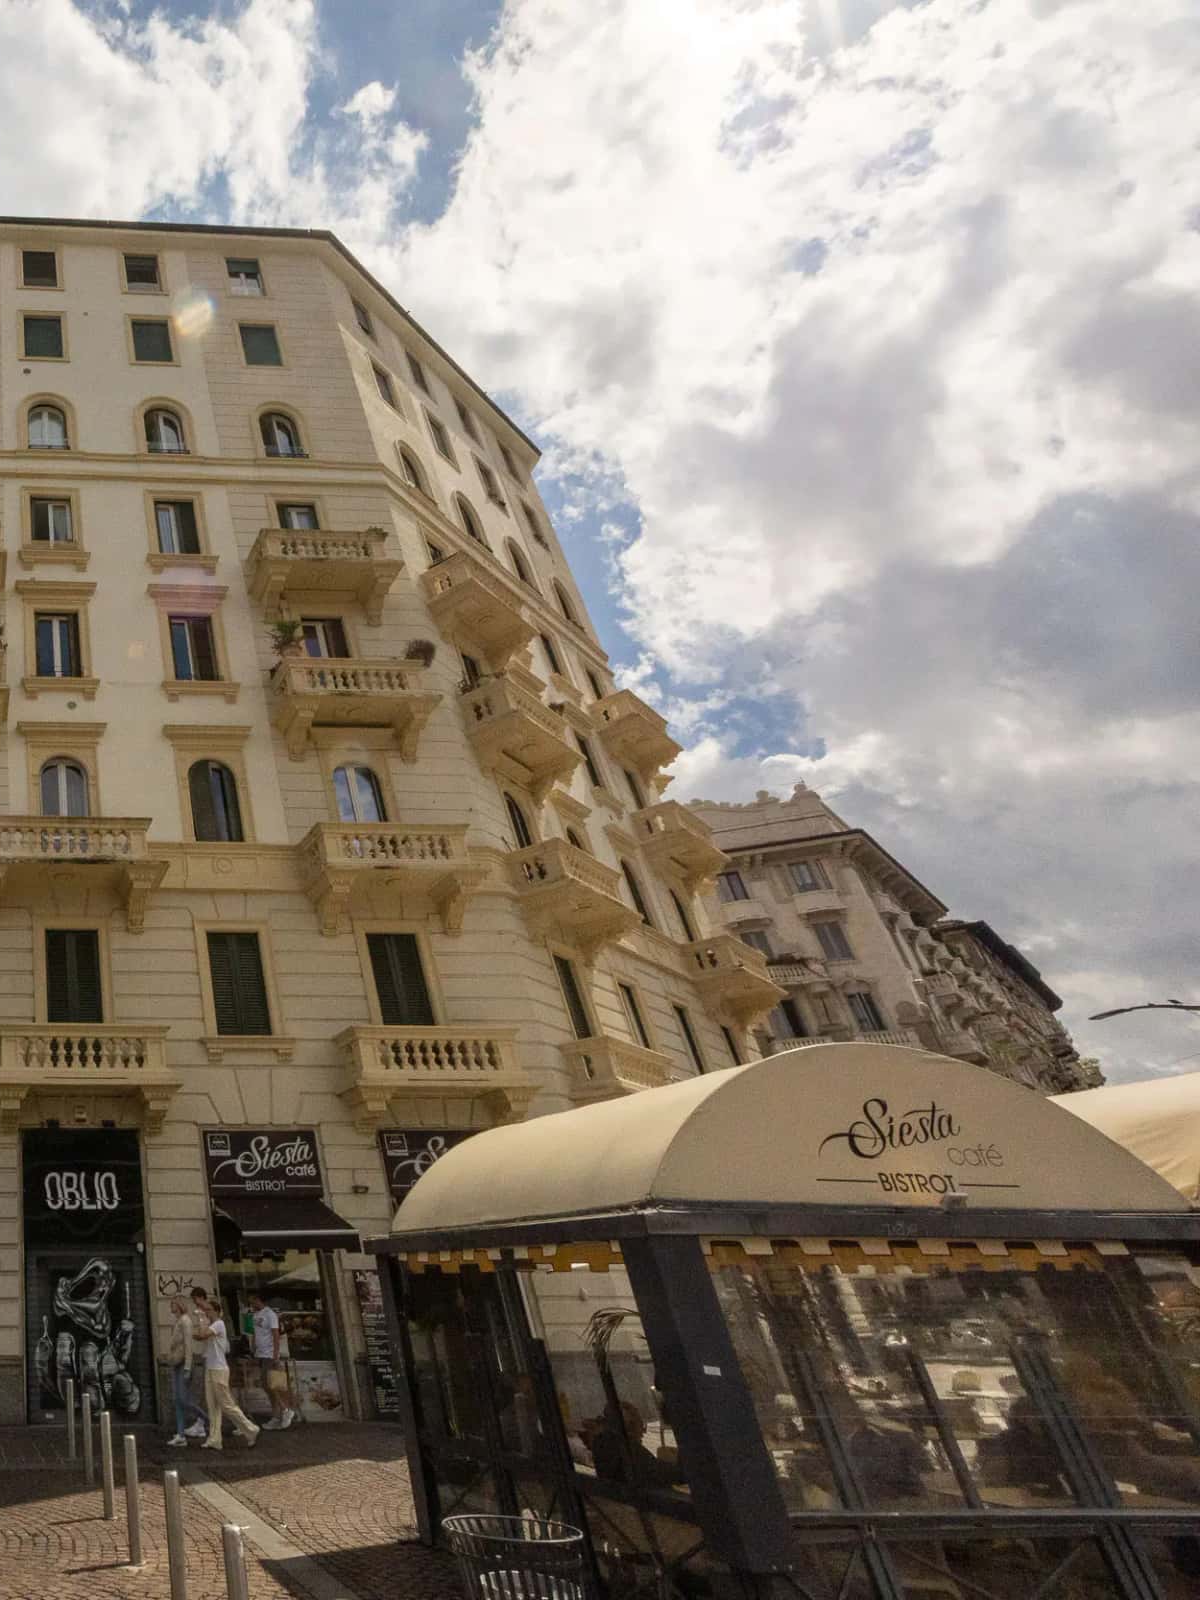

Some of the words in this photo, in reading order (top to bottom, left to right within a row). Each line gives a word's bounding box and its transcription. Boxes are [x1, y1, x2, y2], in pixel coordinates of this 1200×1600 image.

[818, 1098, 961, 1159] Siesta
[213, 1135, 313, 1180] Siesta
[947, 1144, 1004, 1168] café
[285, 1164, 317, 1176] café
[44, 1171, 121, 1210] OBLIO
[245, 1180, 287, 1191] BISTROT
[877, 1172, 956, 1195] BISTROT
